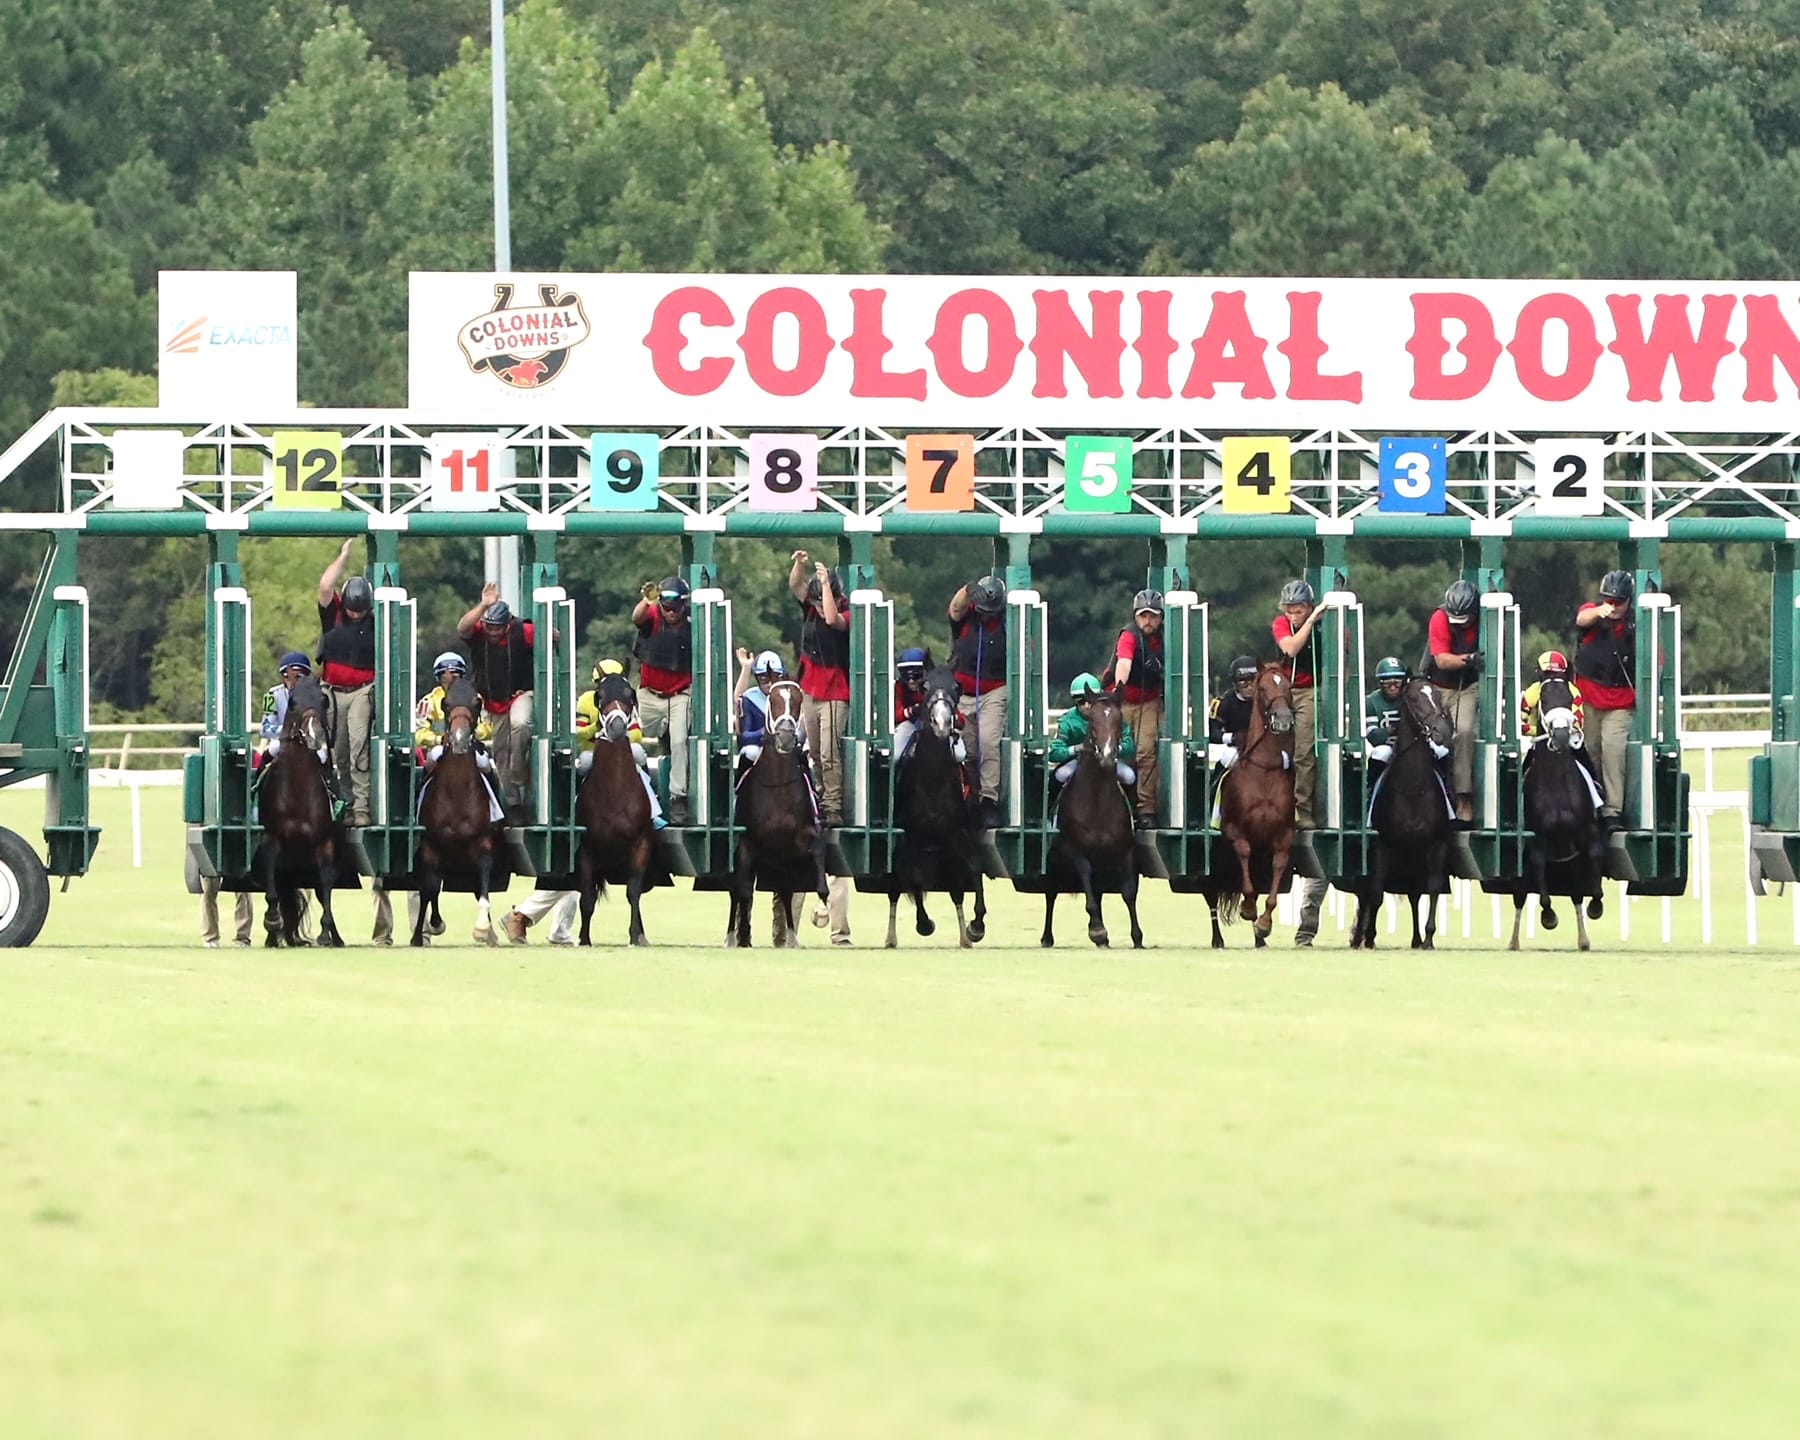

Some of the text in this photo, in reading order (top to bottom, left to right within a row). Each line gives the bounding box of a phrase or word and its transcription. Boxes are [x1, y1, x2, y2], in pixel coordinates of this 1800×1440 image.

[209, 325, 292, 345] EXACTA
[469, 312, 578, 343] COLONIAL
[494, 332, 560, 351] DOWNS
[643, 287, 1363, 404] COLONIAL
[276, 449, 338, 492] 12
[441, 450, 489, 493] 11
[607, 452, 644, 494] 9
[765, 449, 803, 494] 8
[923, 450, 958, 493] 7
[1080, 452, 1119, 497] 5
[1237, 452, 1276, 496] 4
[1393, 453, 1431, 498] 3
[1552, 455, 1588, 498] 2
[263, 696, 276, 712] 12
